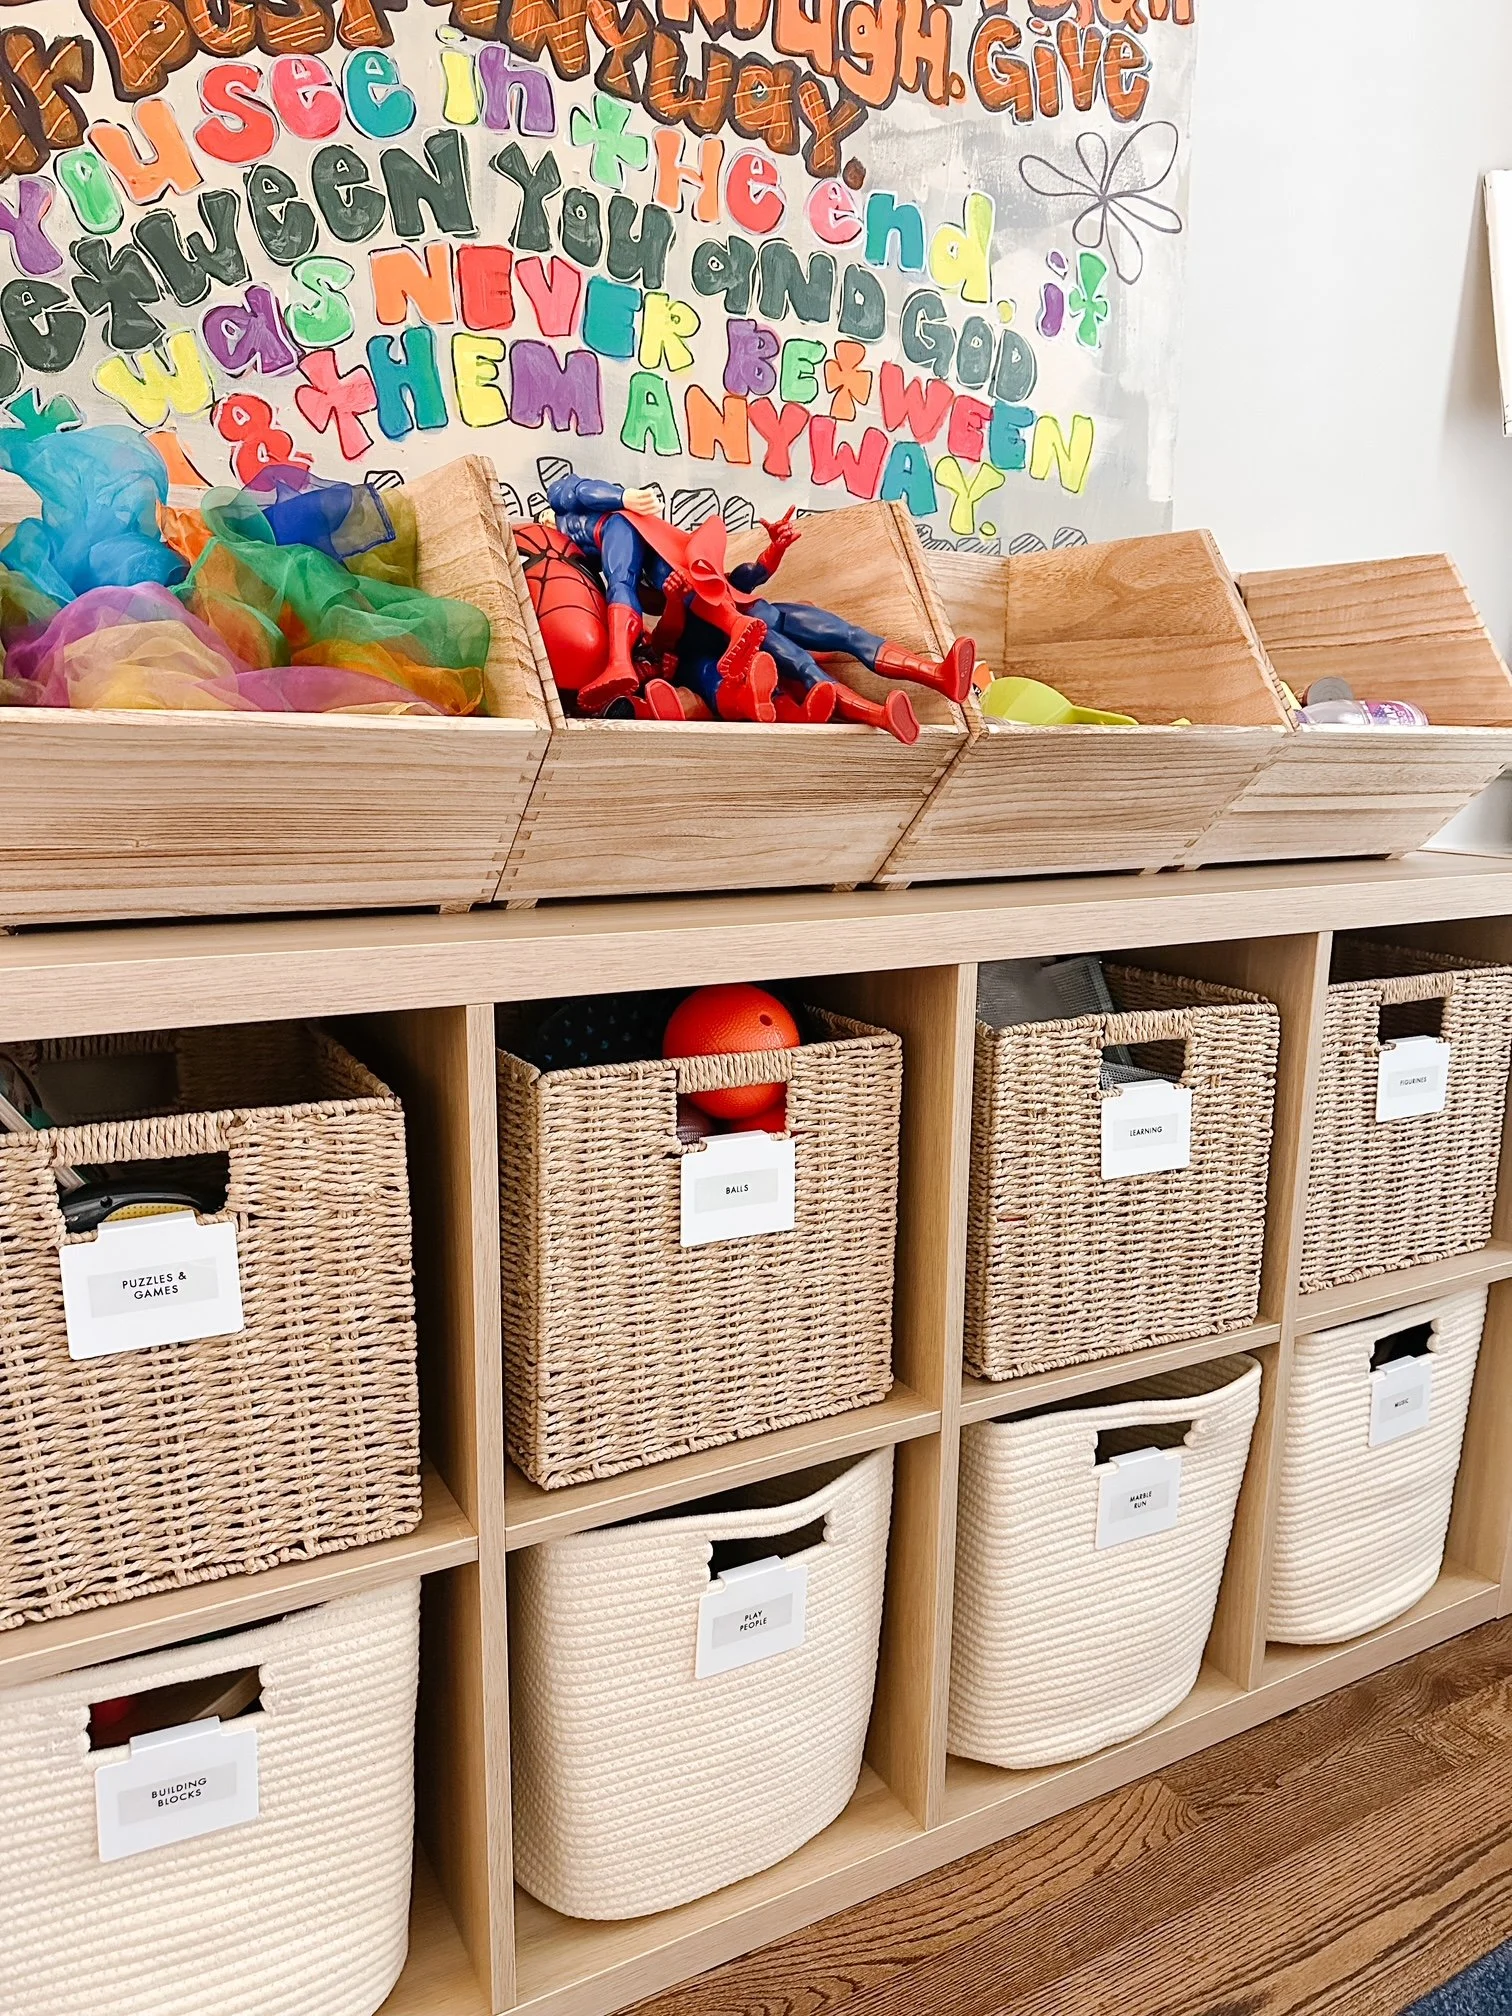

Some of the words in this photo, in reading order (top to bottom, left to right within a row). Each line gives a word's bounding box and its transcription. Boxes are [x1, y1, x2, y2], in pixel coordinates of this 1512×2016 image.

[195, 46, 417, 166] see
[437, 24, 558, 136] in
[568, 92, 787, 236] tHe
[900, 287, 1038, 403] GOD
[368, 243, 702, 374] NEVER
[724, 318, 1094, 494] BEtWEEN
[295, 325, 604, 462] tHEM
[619, 371, 1004, 537] ANYWAY.
[1129, 1125, 1163, 1137] LEARNING
[725, 1183, 749, 1195] BALLS
[121, 1273, 173, 1290] PUZZLES
[177, 1271, 187, 1281] &
[133, 1284, 179, 1300] GAMES
[1129, 1490, 1153, 1503] MARBLE
[1133, 1500, 1147, 1509] RUN
[739, 1616, 768, 1632] PEOPLE
[744, 1610, 763, 1622] PLAY
[151, 1777, 207, 1799] BUILDING
[157, 1788, 202, 1808] BLOCKS
